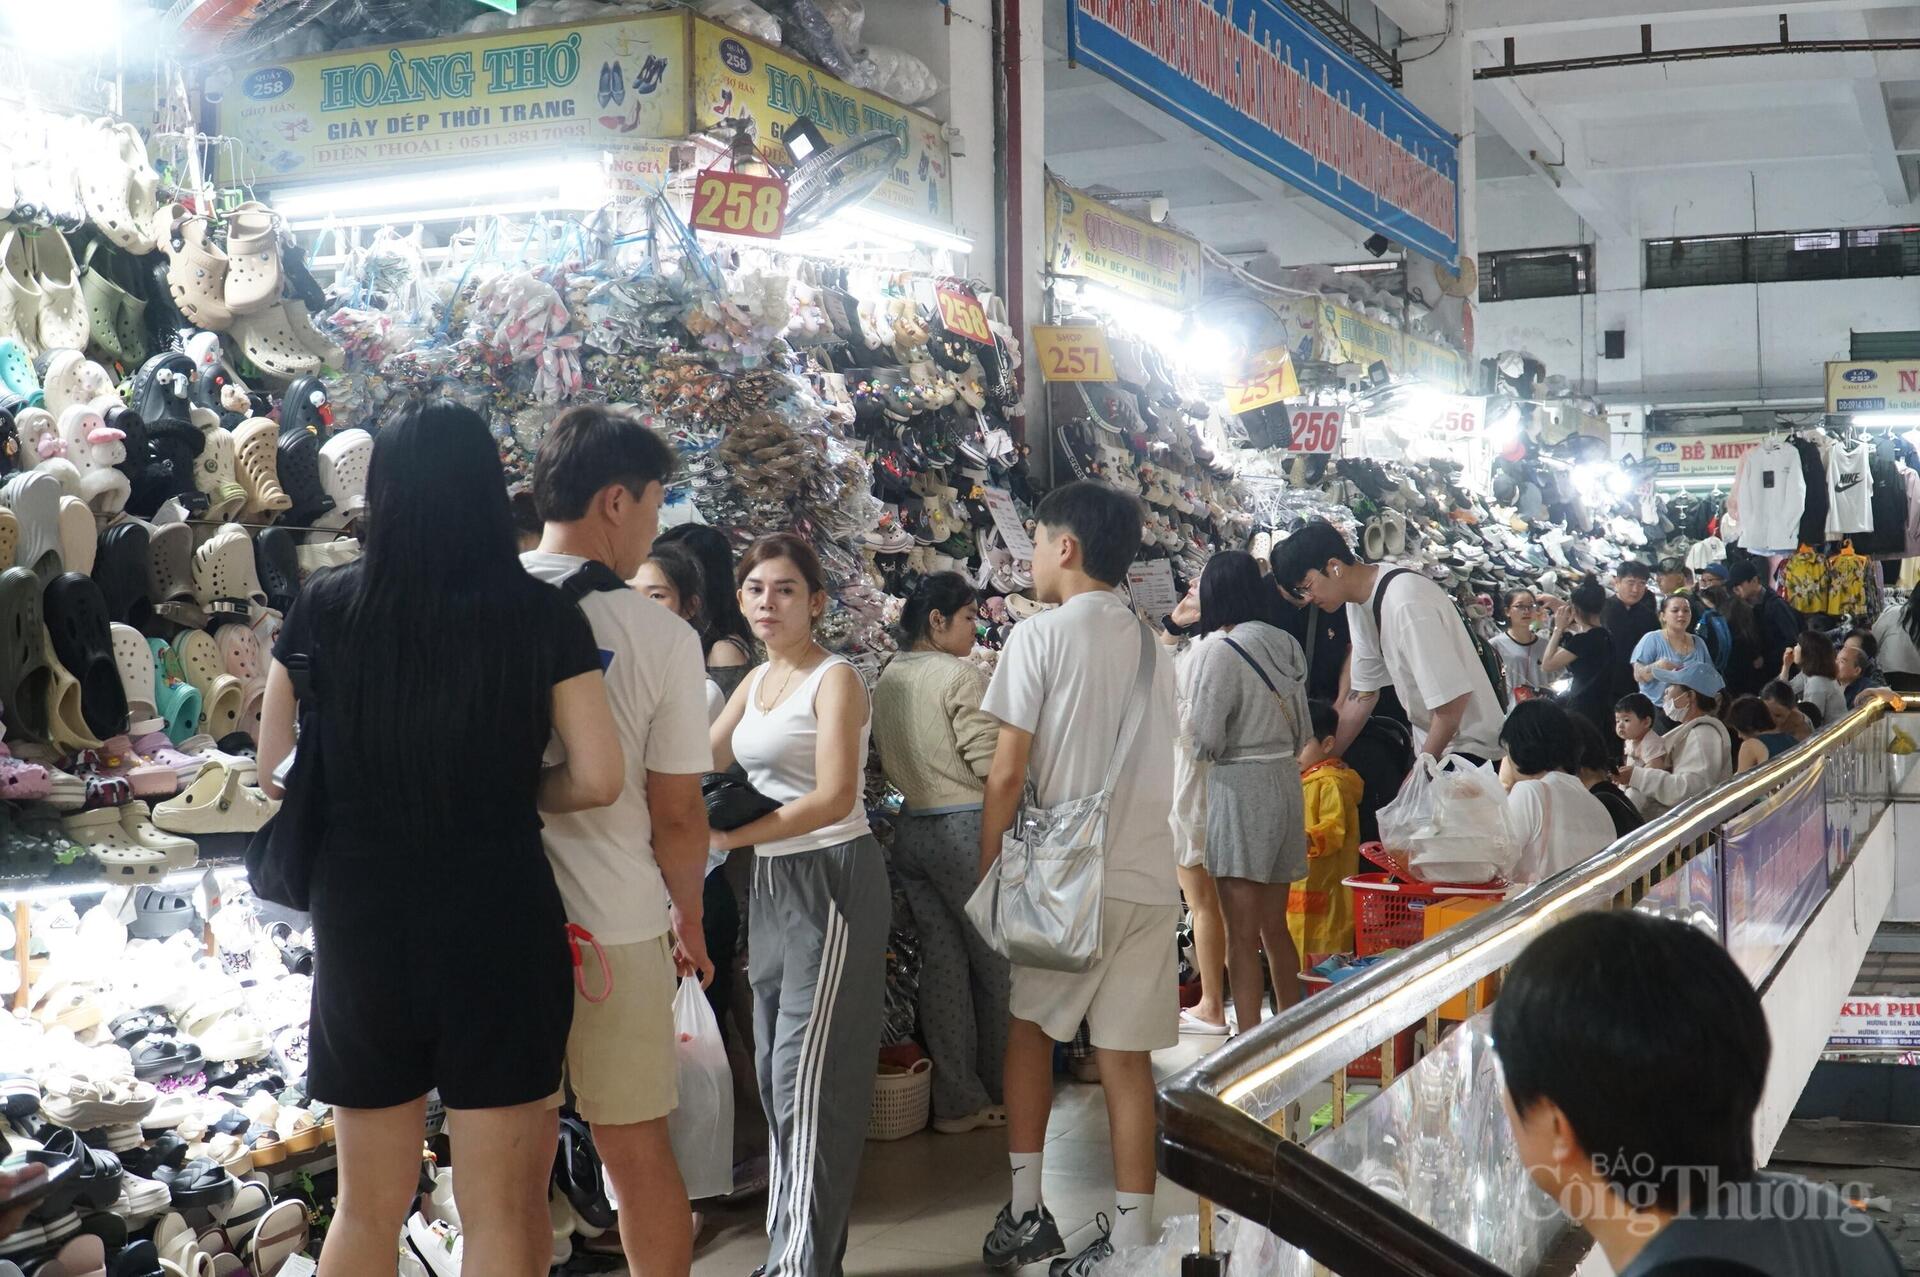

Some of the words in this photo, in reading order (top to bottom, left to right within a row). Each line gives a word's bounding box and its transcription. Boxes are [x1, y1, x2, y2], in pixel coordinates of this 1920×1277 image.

[320, 49, 475, 112] HOÀNG
[482, 32, 582, 94] THƠ
[726, 52, 747, 72] 258
[253, 80, 284, 97] 258
[765, 63, 860, 138] HOÀNG
[327, 117, 378, 141] GIÀY
[386, 112, 430, 134] DÉP
[439, 103, 491, 129] THỜI
[499, 98, 576, 123] TRANG
[695, 179, 781, 235] 258
[938, 291, 989, 340] 258
[1056, 333, 1082, 342] SHOP
[1048, 345, 1100, 375] 257
[1238, 366, 1284, 405] 257
[1287, 411, 1340, 452] 256
[1430, 411, 1476, 432] 256
[1839, 472, 1861, 484] NIKE
[1840, 1002, 1881, 1018] KIM
